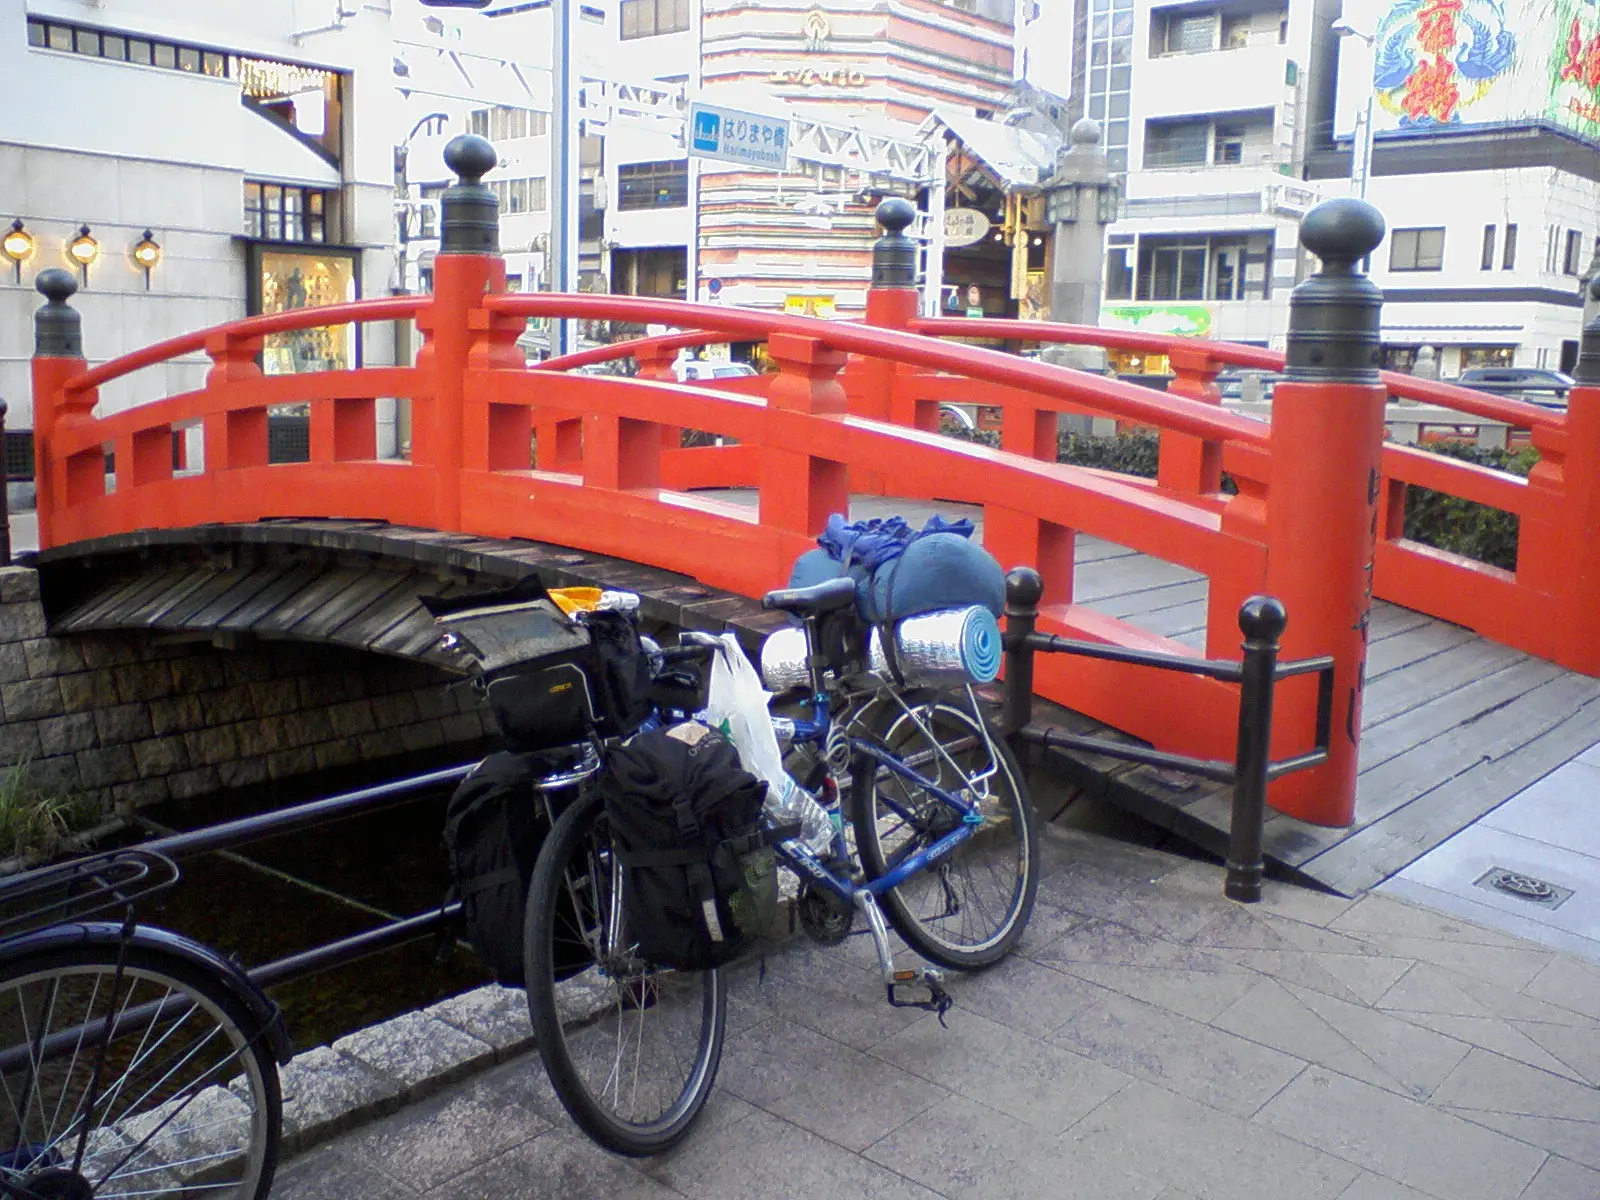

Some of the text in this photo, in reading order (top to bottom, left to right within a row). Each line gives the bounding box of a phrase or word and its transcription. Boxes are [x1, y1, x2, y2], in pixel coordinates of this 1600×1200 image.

[723, 118, 785, 149] はりまや橋
